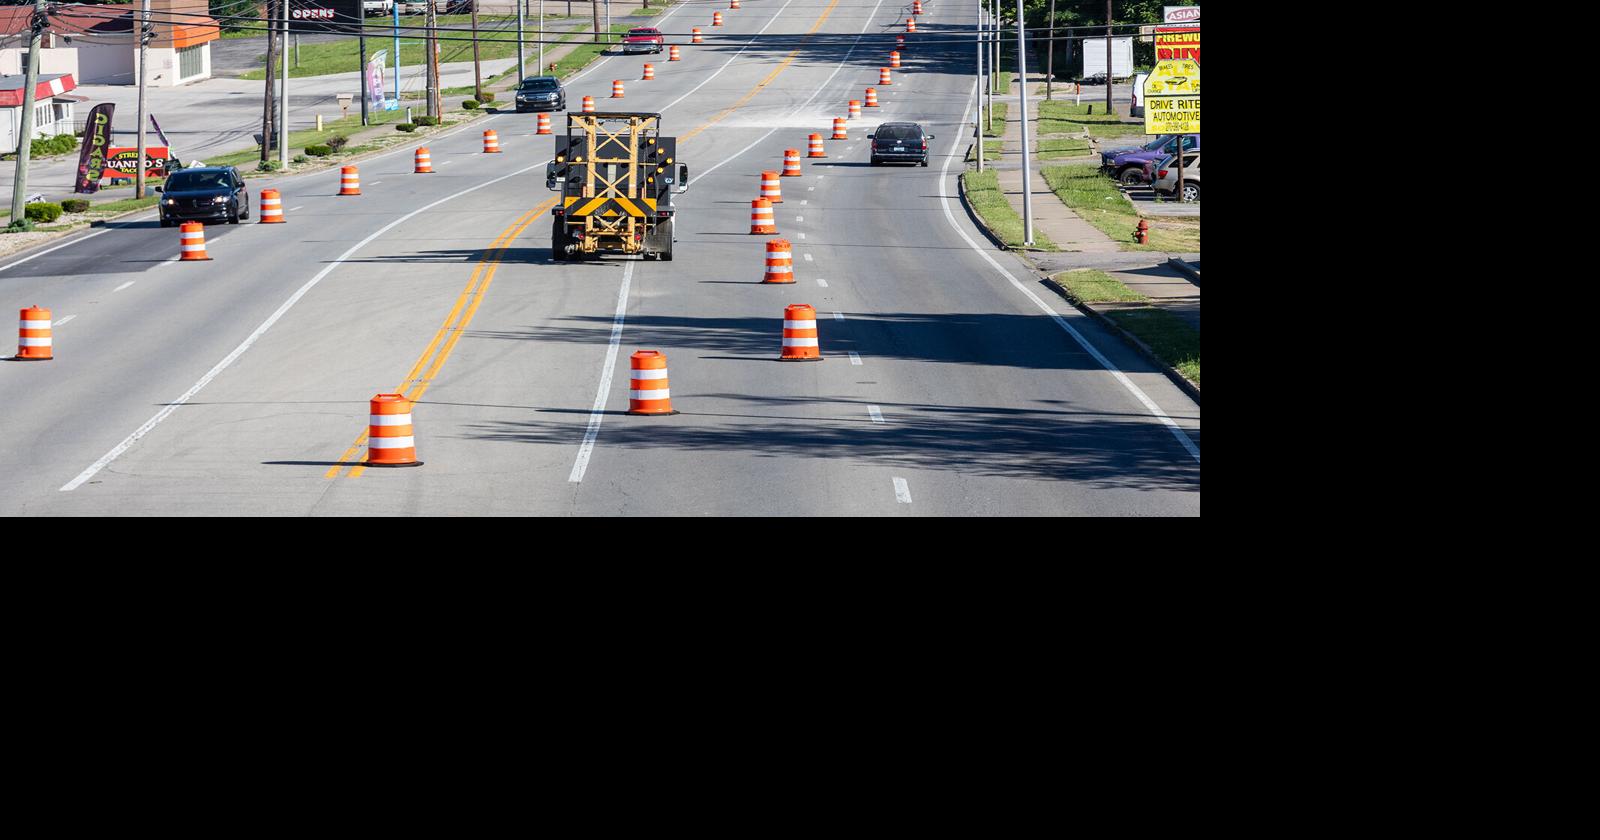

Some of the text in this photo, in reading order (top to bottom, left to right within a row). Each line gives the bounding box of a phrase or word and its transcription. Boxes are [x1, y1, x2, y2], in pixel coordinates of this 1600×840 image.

[292, 9, 335, 18] OPENS
[1169, 9, 1200, 20] ASIAN
[1150, 99, 1200, 109] DRIVE RITE
[1154, 111, 1200, 121] AUTOMOTIVE
